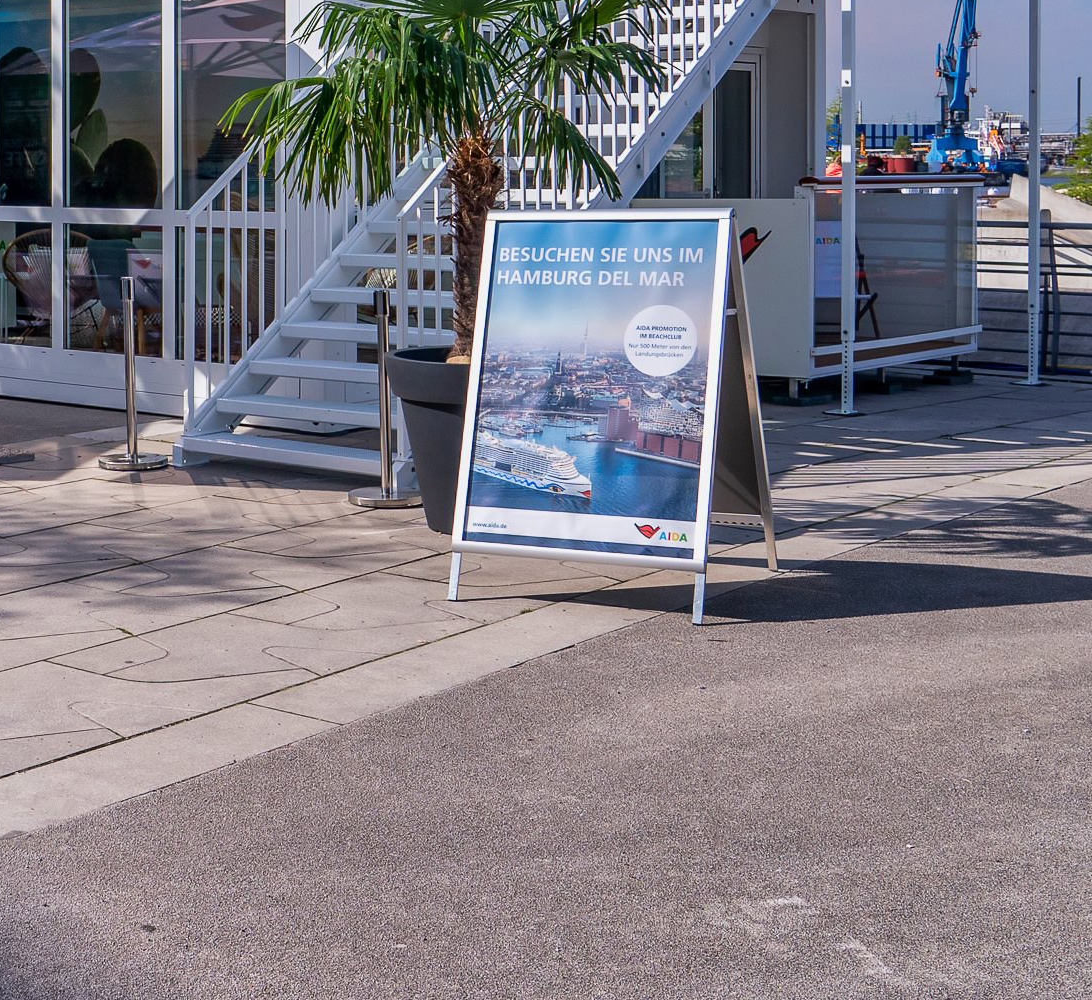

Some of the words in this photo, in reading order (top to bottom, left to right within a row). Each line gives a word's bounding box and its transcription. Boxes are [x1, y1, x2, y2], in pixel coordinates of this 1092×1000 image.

[816, 237, 841, 245] AIDA
[499, 247, 594, 263] BESUCHEN
[600, 248, 627, 263] SIE
[633, 248, 673, 263] UNS
[679, 248, 704, 264] IM
[497, 270, 592, 285] HAMBURG
[598, 271, 633, 286] DEL
[639, 271, 684, 287] MAR
[659, 531, 688, 543] AIDA
